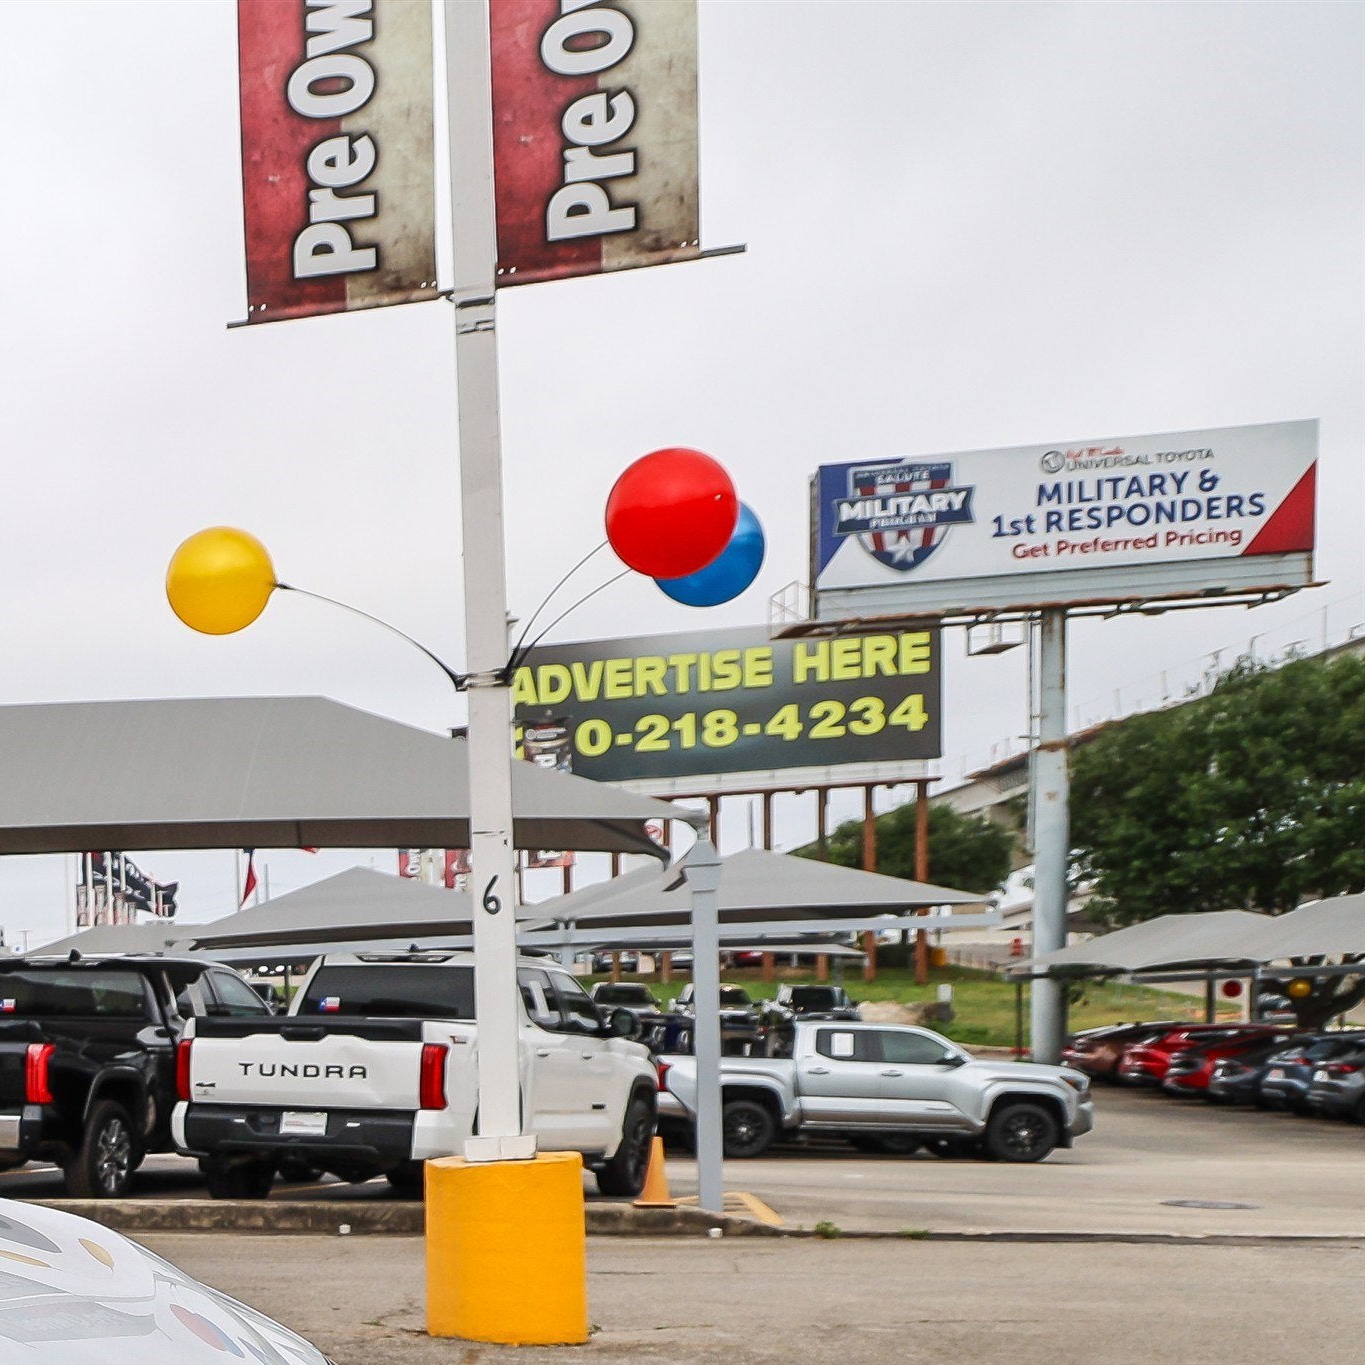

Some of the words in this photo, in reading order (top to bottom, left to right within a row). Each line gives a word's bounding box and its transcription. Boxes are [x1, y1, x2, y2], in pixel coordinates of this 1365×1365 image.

[540, 0, 634, 75] O
[546, 89, 635, 242] Pre
[293, 135, 376, 278] Pre
[1156, 448, 1215, 463] TOYOTA
[839, 490, 968, 522] MILITARY
[1036, 470, 1191, 507] MILITARY
[1198, 468, 1220, 493] &
[991, 513, 1036, 538] 1st
[1045, 492, 1267, 534] RESPONDERS
[1012, 542, 1050, 560] Get
[1056, 533, 1159, 556] Preferred
[1165, 528, 1243, 547] Pricing
[511, 646, 774, 707] ADVERTISE
[792, 631, 932, 685] HERE
[515, 692, 930, 760] 0-218-4234
[482, 873, 503, 916] 6
[237, 1062, 368, 1079] TUNDRA
